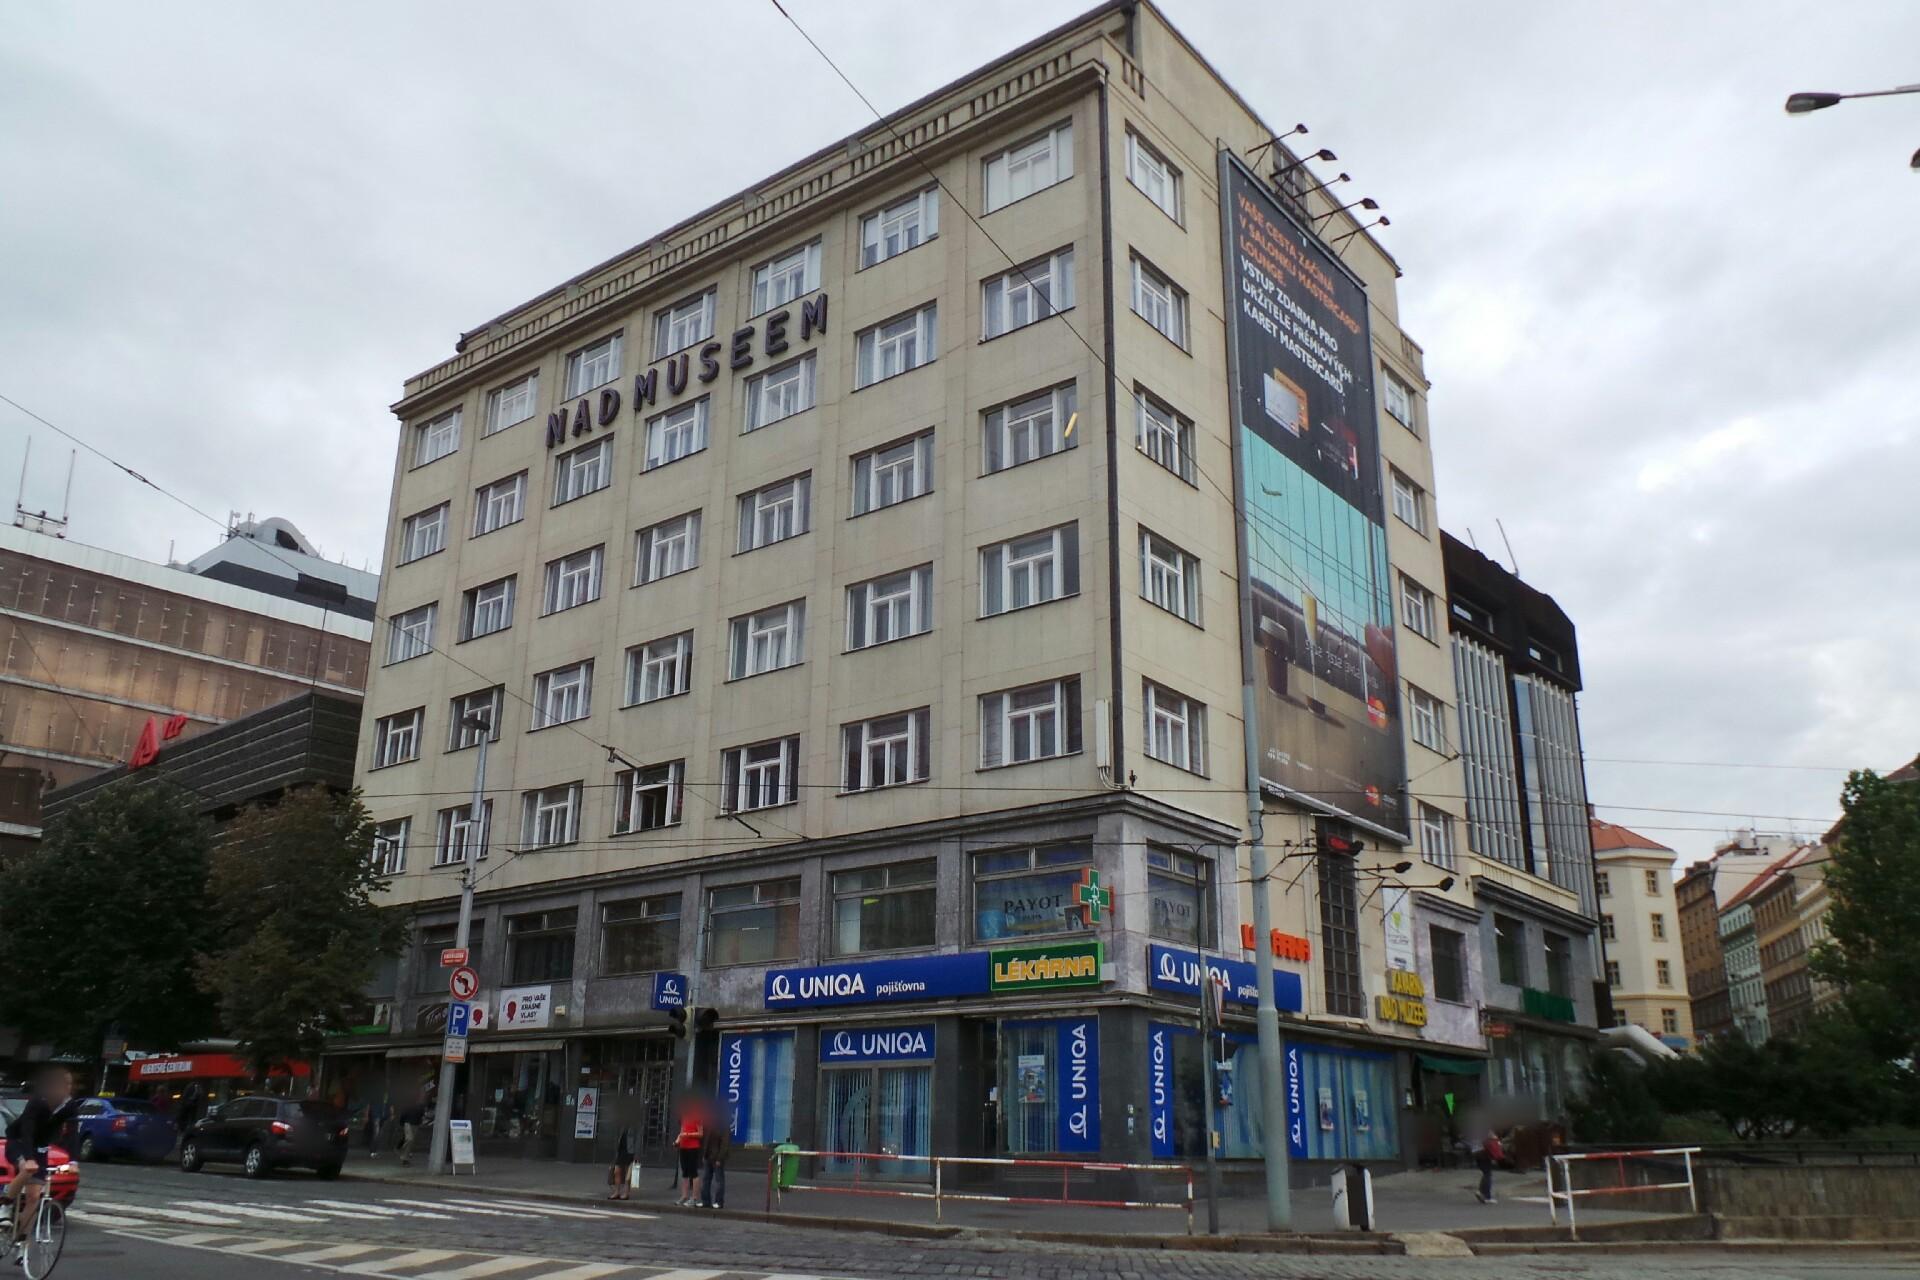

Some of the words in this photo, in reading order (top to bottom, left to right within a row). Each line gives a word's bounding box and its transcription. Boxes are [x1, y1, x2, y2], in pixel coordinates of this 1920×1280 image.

[1239, 214, 1248, 229] V
[1266, 222, 1297, 258] CESTA
[1241, 254, 1276, 293] VSTUP
[1277, 288, 1319, 335] ZDARMA
[1320, 326, 1338, 352] PRO
[1242, 277, 1291, 330] DRŽITELE
[1243, 299, 1278, 338] KARET
[546, 388, 621, 448] NAD
[634, 293, 828, 412] MUSEEM
[1004, 894, 1063, 913] PAYOT
[1153, 897, 1192, 918] PAYOT
[800, 973, 865, 998] UNIQA
[876, 979, 926, 997] pojišťovna
[994, 954, 1096, 983] LÉKÁRNA
[659, 994, 683, 1006] UNIQA
[861, 1031, 927, 1055] UNIQA
[1072, 1024, 1086, 1099] UNIQA
[728, 1039, 742, 1102] UNIQA
[1153, 1031, 1165, 1105] UNIQA
[1289, 1048, 1300, 1114] UNIQA
